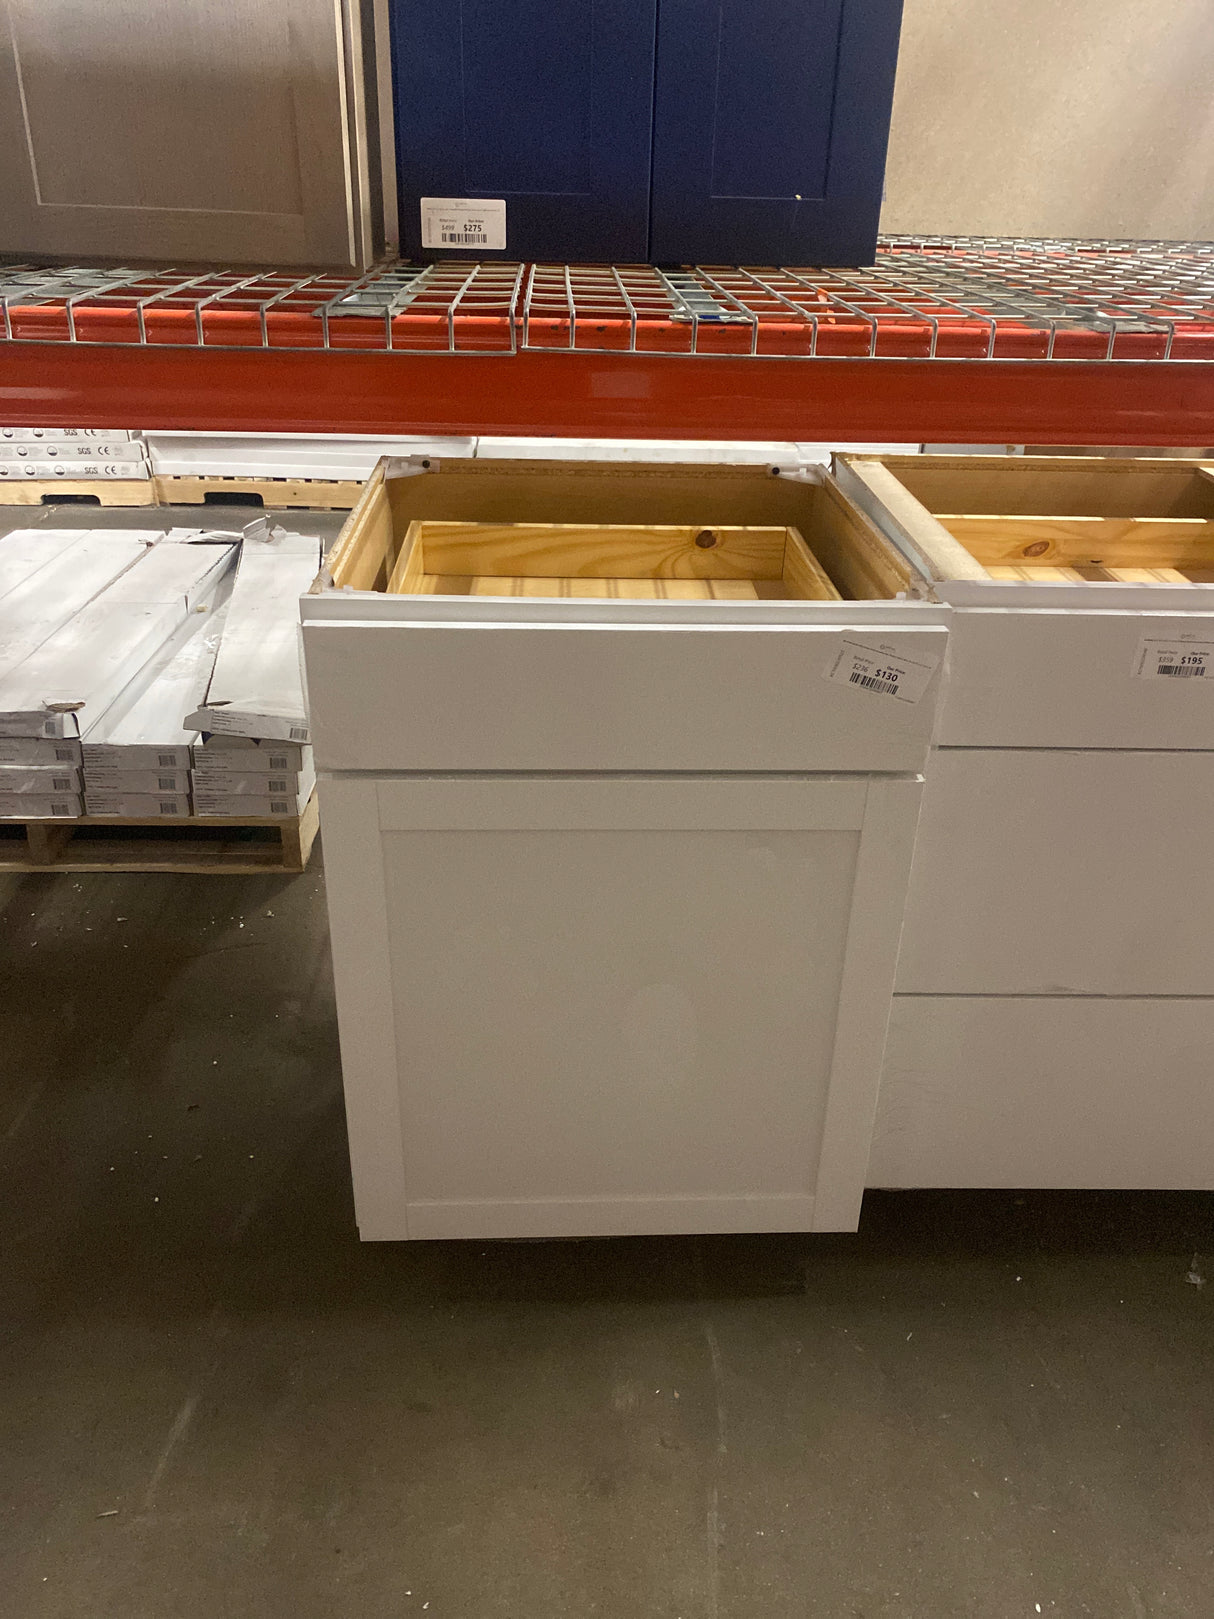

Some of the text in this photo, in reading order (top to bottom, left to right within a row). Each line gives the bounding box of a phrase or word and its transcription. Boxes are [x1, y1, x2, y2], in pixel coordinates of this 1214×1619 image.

[463, 224, 482, 232] $275
[77, 447, 91, 455] SGS
[84, 467, 98, 475] SGS
[1181, 656, 1203, 665] $195
[875, 669, 898, 682] $130
